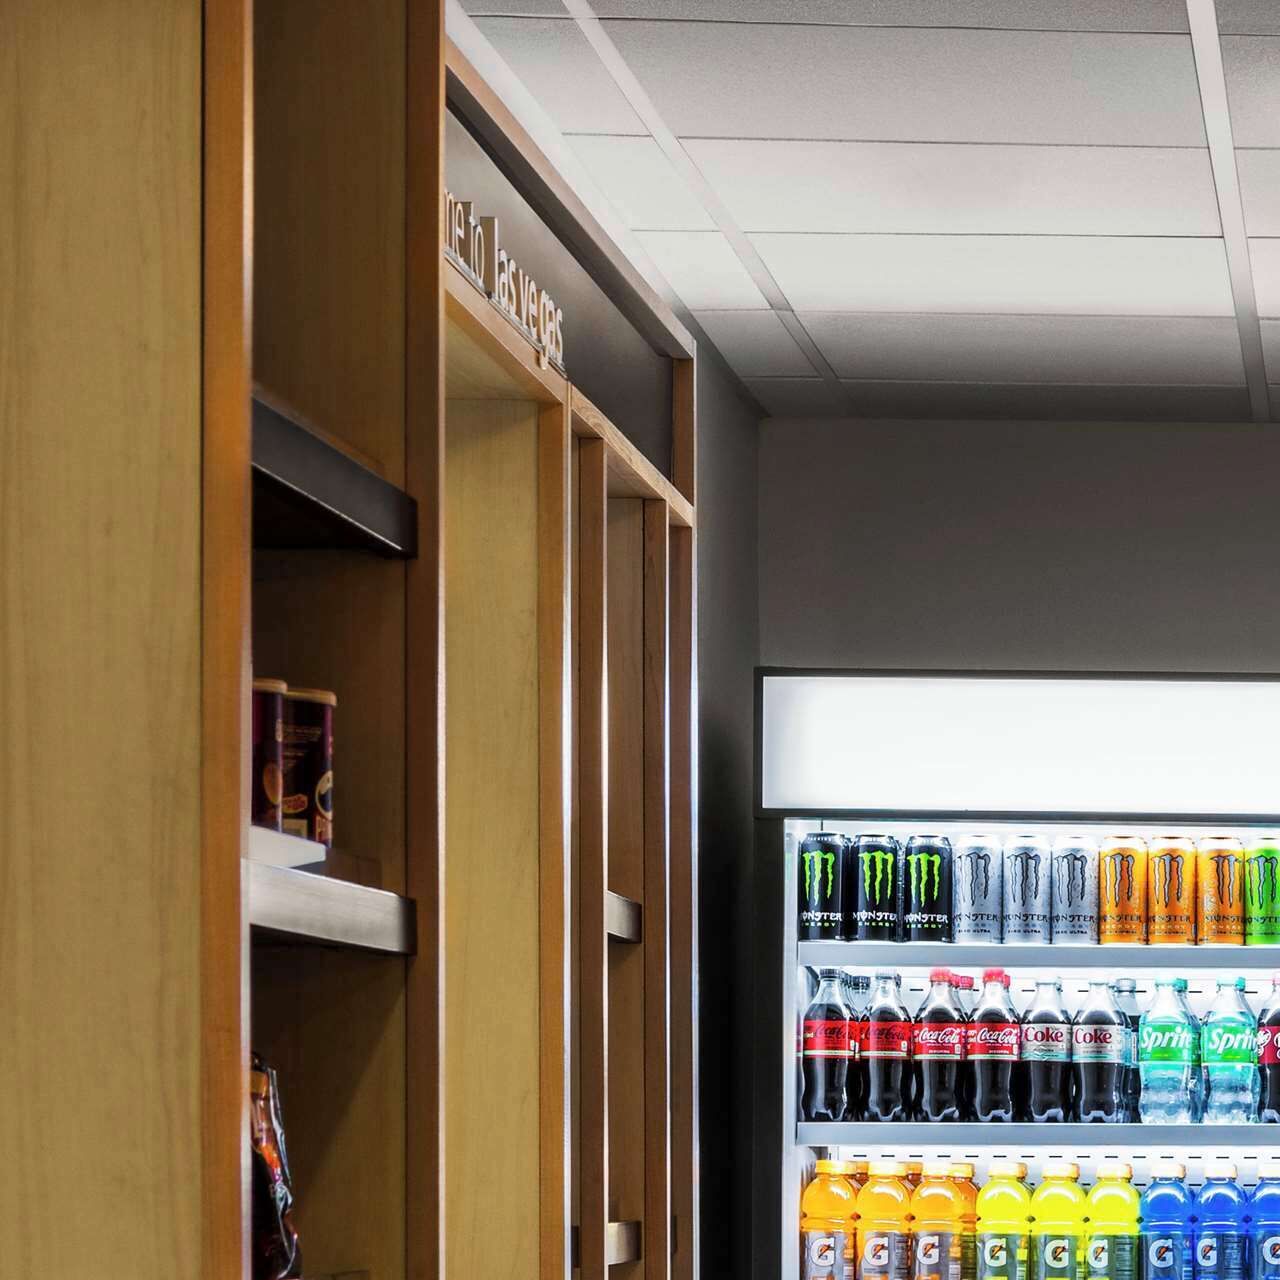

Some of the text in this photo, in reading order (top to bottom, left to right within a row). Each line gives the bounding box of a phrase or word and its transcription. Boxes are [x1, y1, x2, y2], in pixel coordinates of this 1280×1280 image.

[918, 1027, 960, 1044] Coca-Cola
[1024, 1026, 1064, 1043] Coke
[1074, 1027, 1113, 1044] Coke
[1208, 1028, 1256, 1054] Sprit
[811, 1237, 835, 1267] G
[864, 1236, 889, 1267] G
[917, 1236, 940, 1265] G
[983, 1237, 1007, 1267] G
[1044, 1239, 1070, 1269] G
[1087, 1239, 1109, 1269] G
[1150, 1239, 1173, 1268] G
[1197, 1237, 1217, 1267] G
